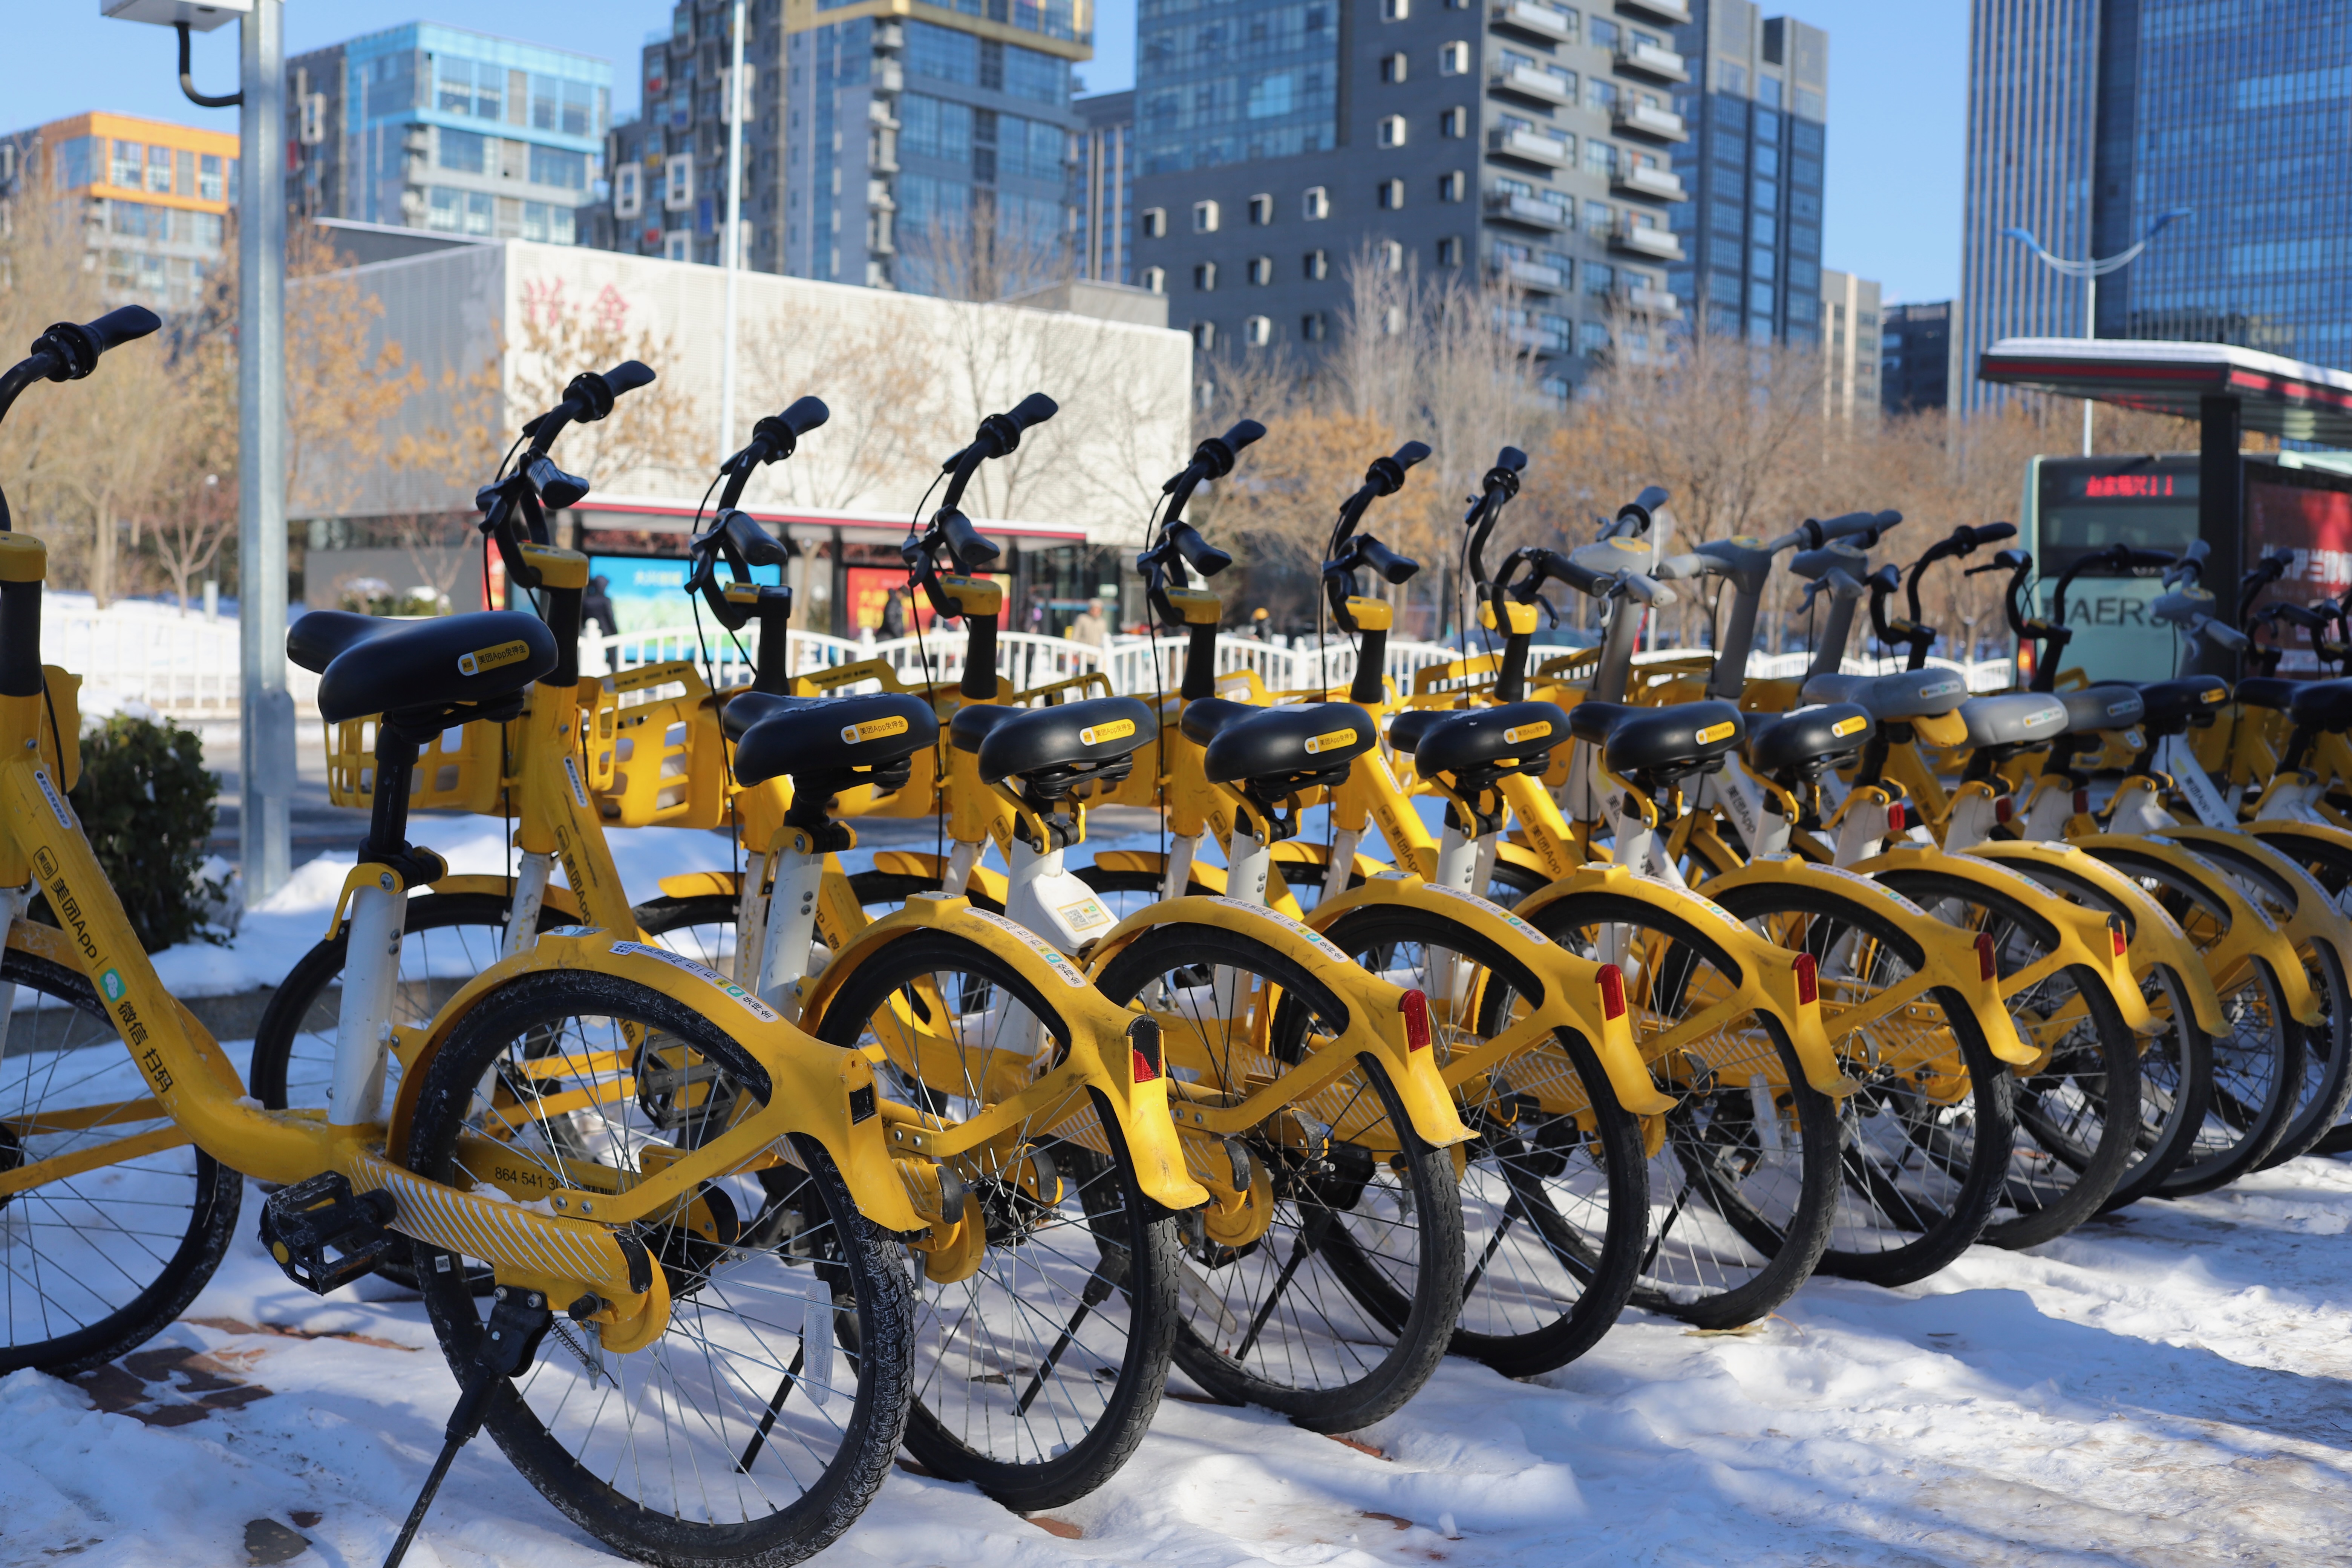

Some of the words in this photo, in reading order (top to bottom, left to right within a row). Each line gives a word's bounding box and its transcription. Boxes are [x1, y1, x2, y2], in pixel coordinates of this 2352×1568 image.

[478, 645, 526, 665] 美团App免押金
[860, 720, 905, 735] 美团App免押金
[1095, 723, 1132, 737] 美团App免押金
[1058, 963, 1082, 985] 免押金
[51, 877, 97, 958] 美团App
[118, 1001, 148, 1046] 微信
[143, 1048, 173, 1093] 扫码
[743, 996, 773, 1019] 免押金
[495, 1167, 517, 1183] 864
[522, 1172, 542, 1188] 541
